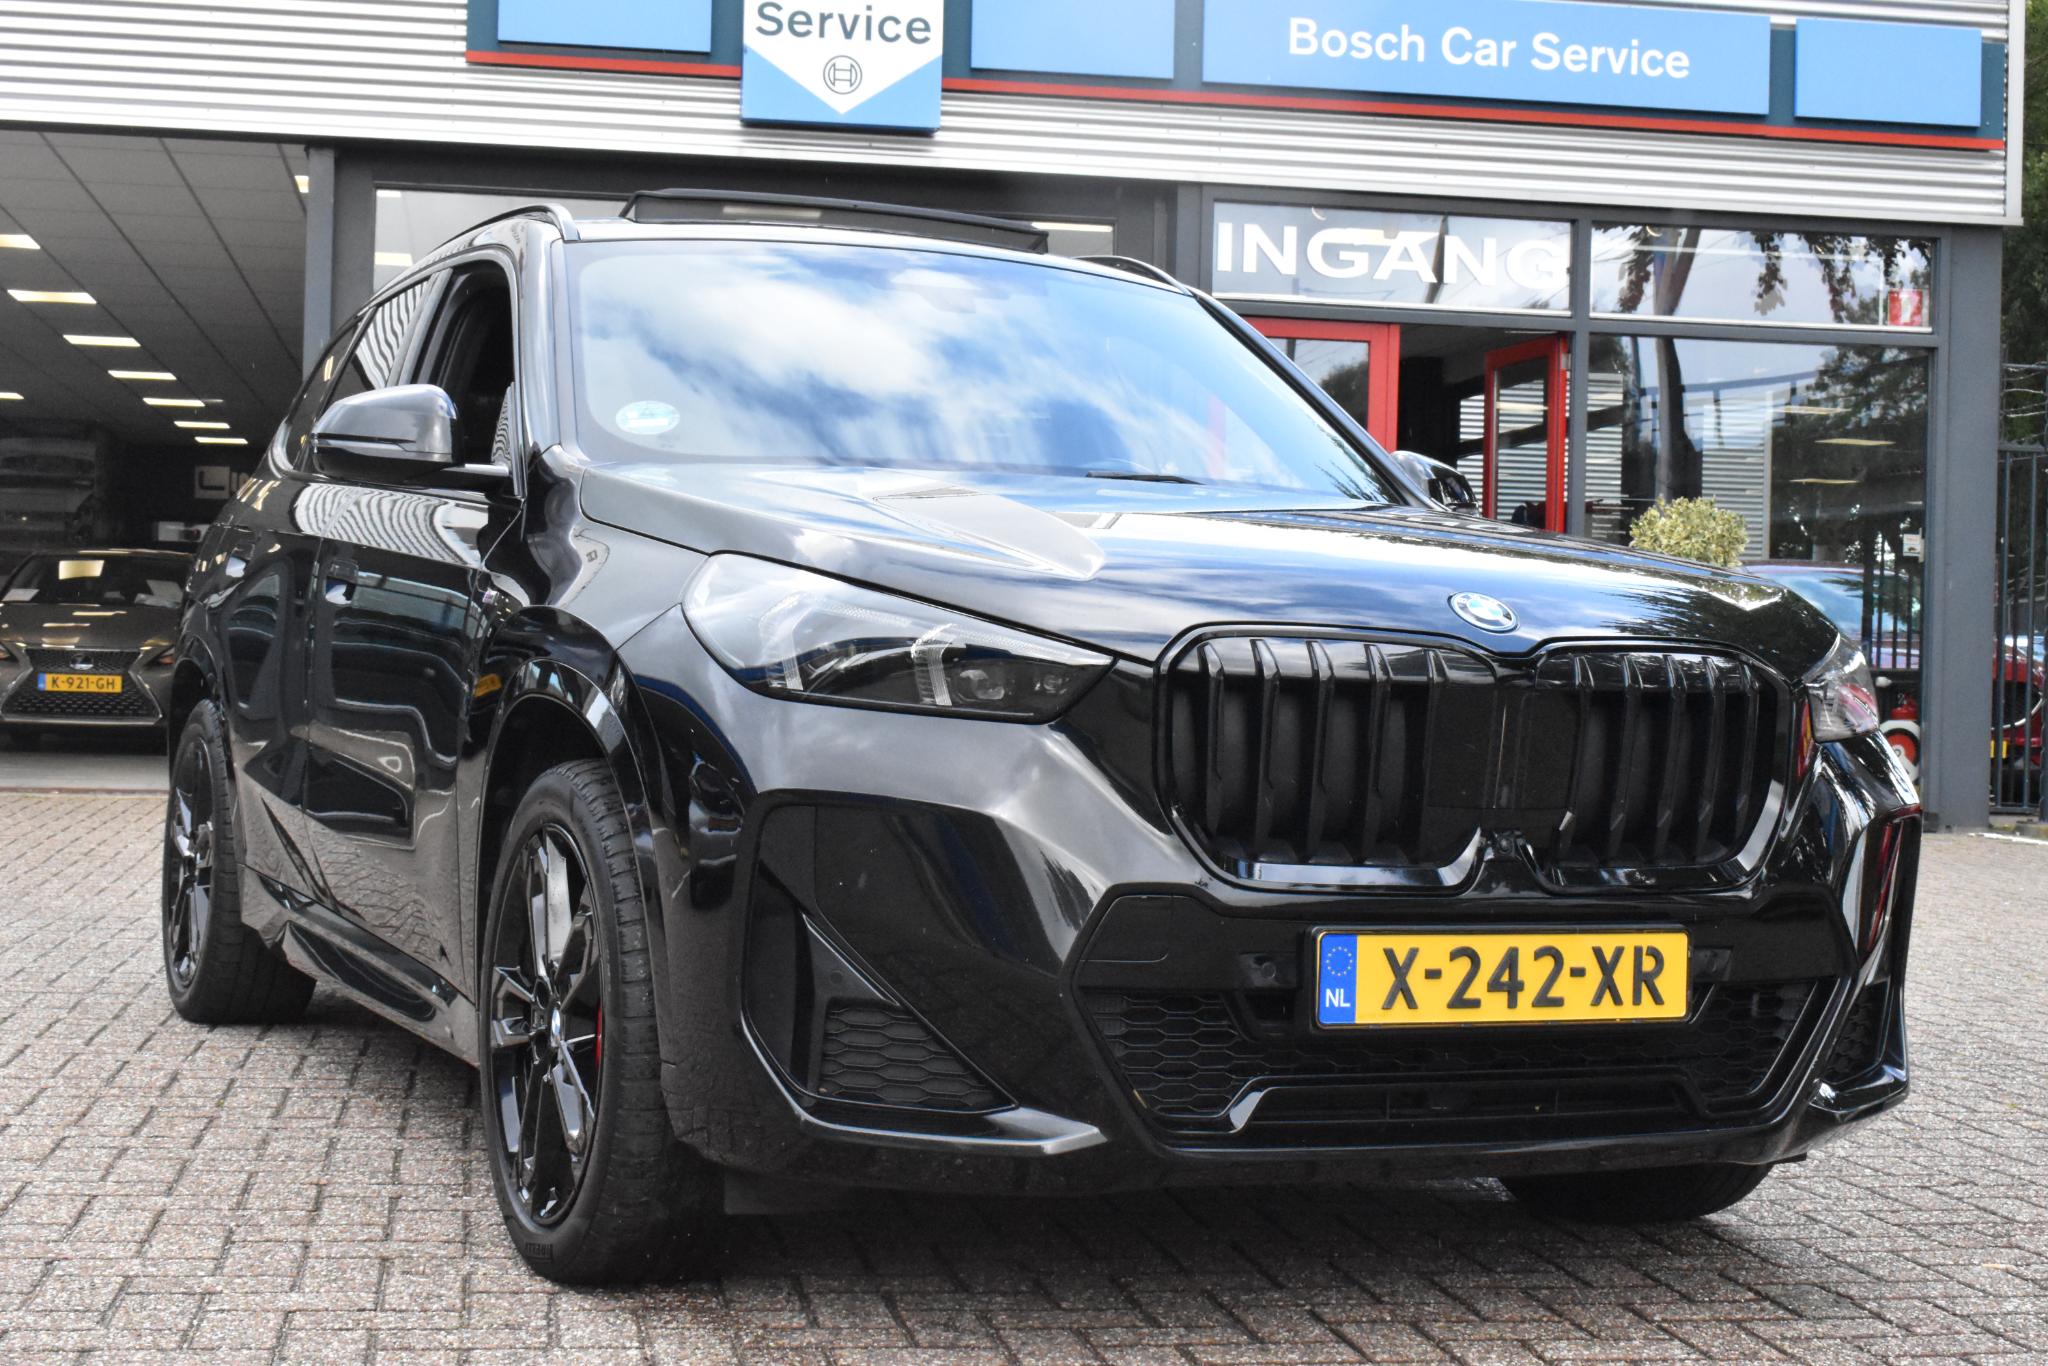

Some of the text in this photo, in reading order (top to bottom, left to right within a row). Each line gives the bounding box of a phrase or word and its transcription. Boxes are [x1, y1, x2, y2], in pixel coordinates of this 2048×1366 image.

[756, 1, 931, 44] Service
[1289, 17, 1691, 79] Bosch Car Service
[1216, 222, 1570, 289] INGANG
[51, 675, 115, 690] K-921-GH
[1325, 988, 1351, 1007] NL
[1381, 945, 1665, 1010] X-242-XR
